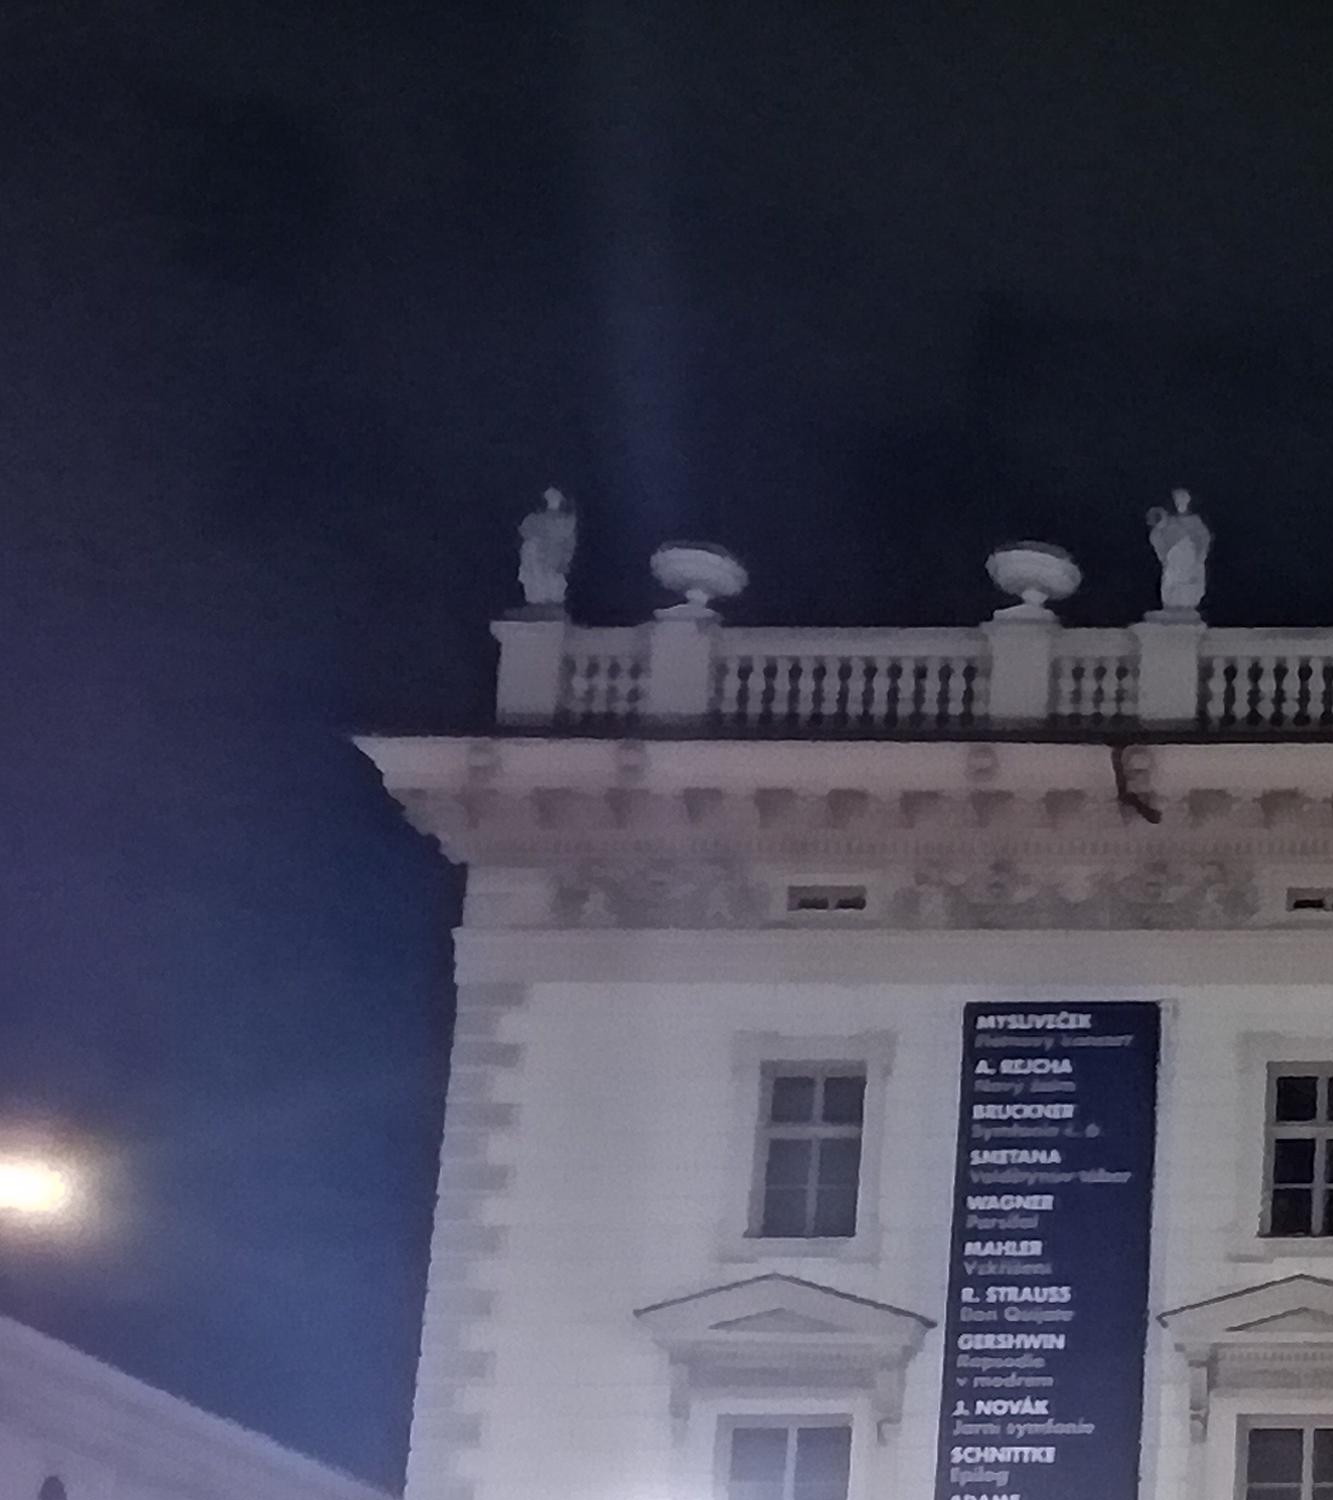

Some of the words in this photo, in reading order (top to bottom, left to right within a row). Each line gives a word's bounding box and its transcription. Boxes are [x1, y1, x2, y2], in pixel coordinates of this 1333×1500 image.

[970, 1149, 1062, 1165] SMETANA
[966, 1195, 1054, 1210] WAGNER
[964, 1240, 1043, 1256] MAHLER
[986, 1286, 1071, 1303] STRAUSS
[957, 1333, 1066, 1350] GERSHWIN
[975, 1395, 1049, 1416] NOVÁK
[950, 1446, 1056, 1464] SCHNITTKE
